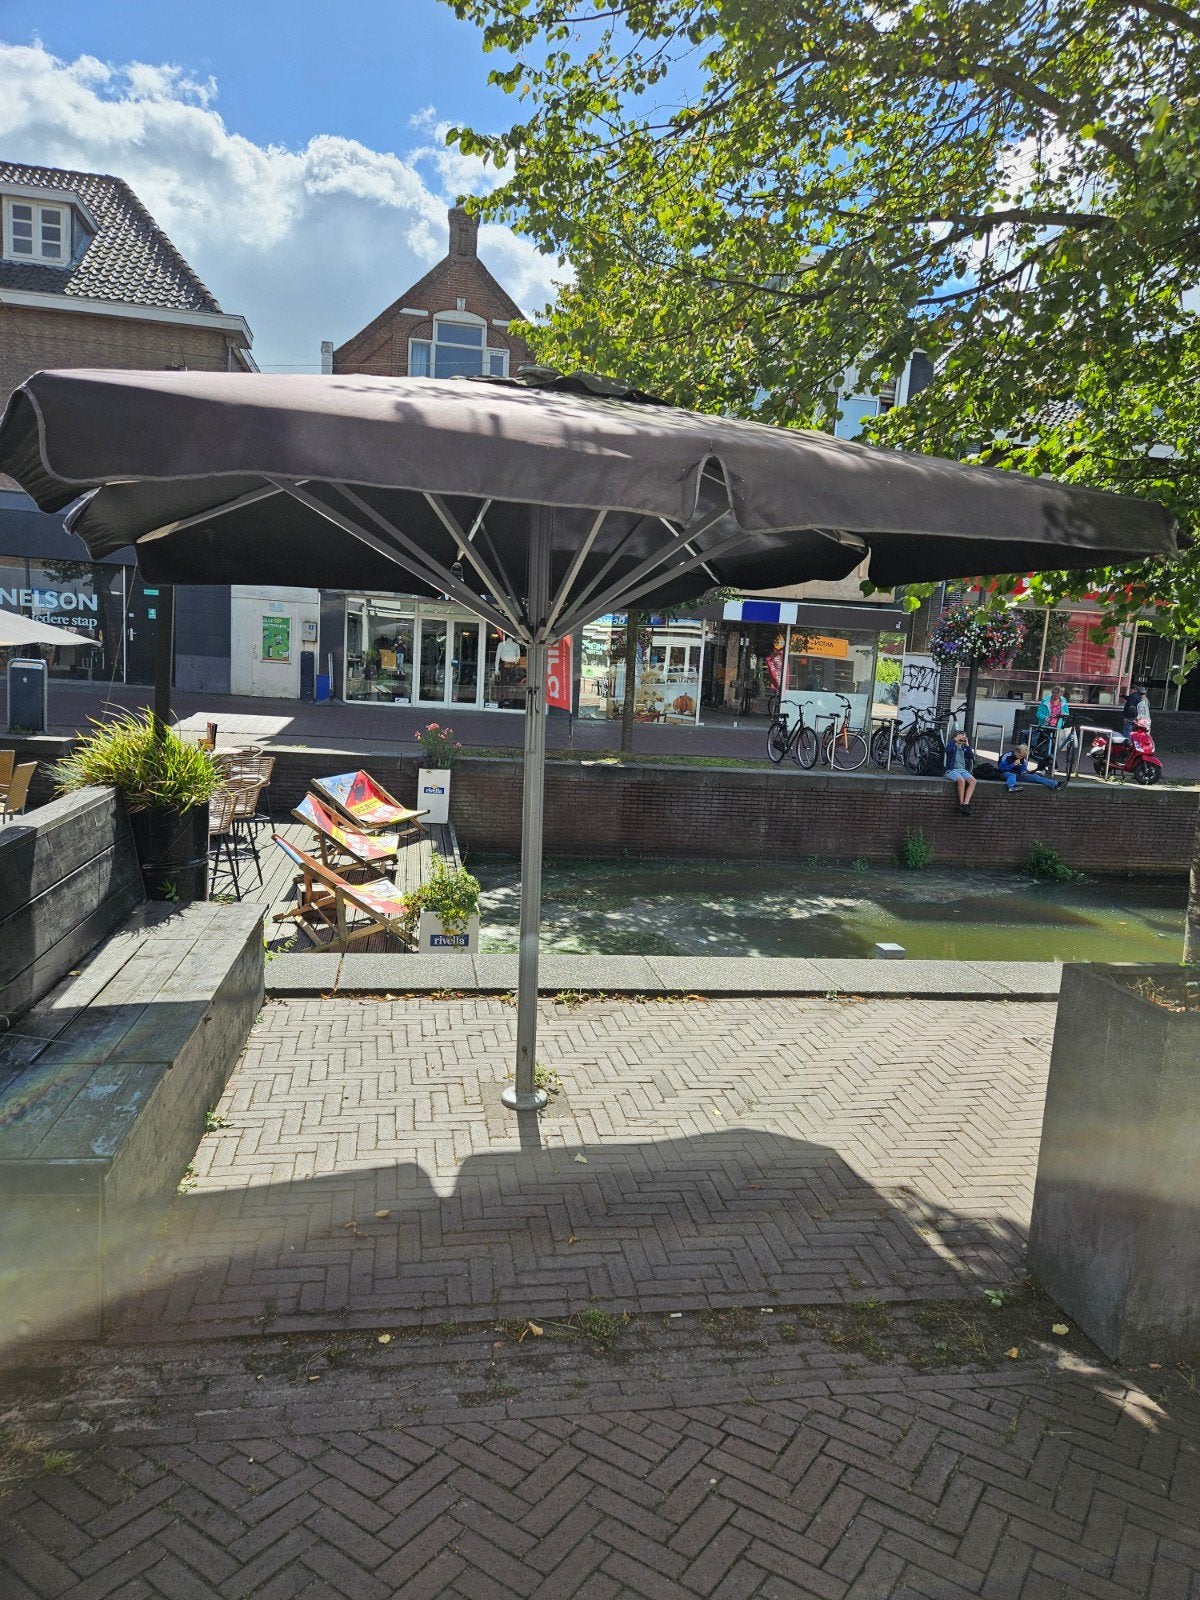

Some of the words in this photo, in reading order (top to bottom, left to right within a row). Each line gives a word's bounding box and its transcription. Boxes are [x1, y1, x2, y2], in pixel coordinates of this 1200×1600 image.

[0, 587, 98, 611] NELSON
[71, 615, 97, 630] stap
[433, 935, 466, 945] rivella
